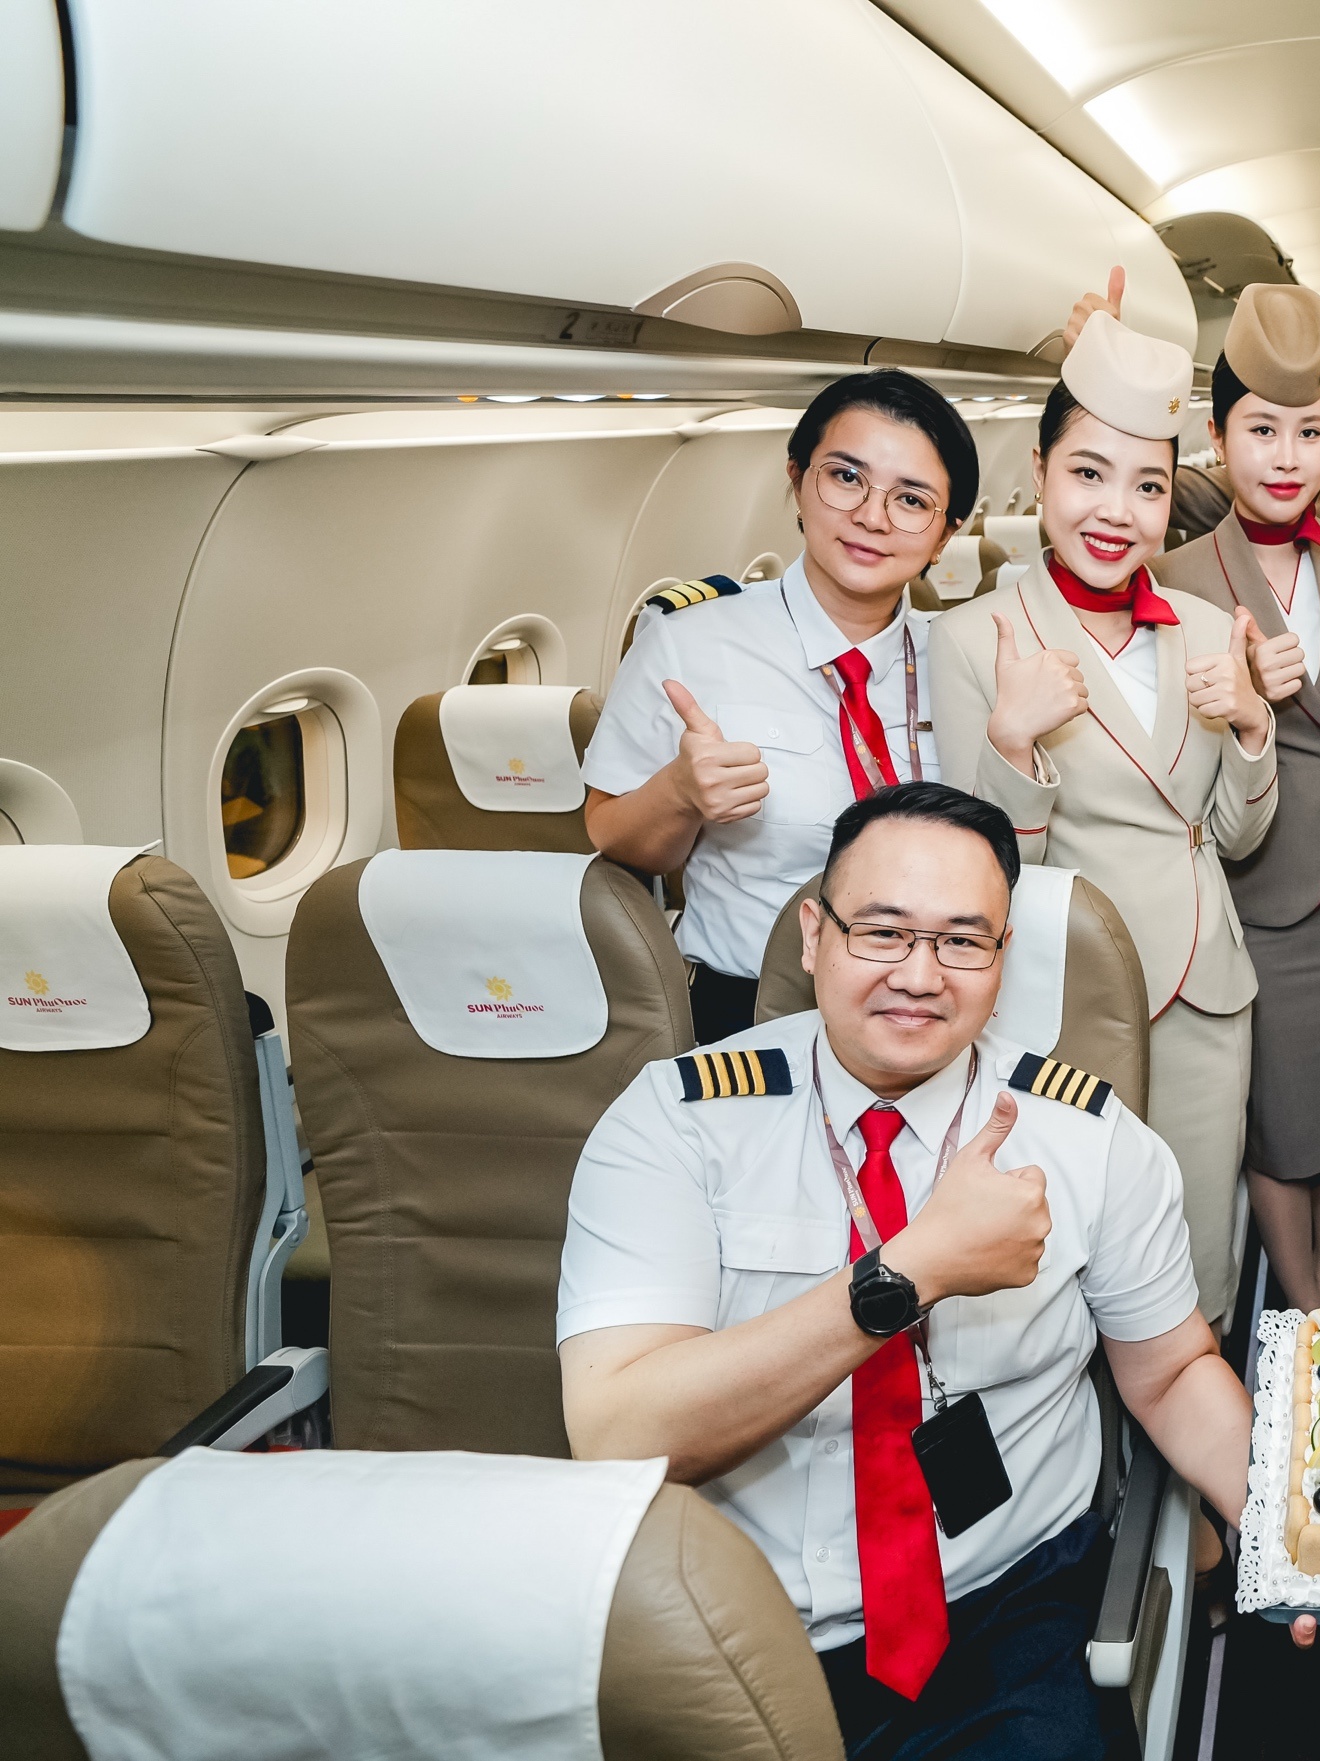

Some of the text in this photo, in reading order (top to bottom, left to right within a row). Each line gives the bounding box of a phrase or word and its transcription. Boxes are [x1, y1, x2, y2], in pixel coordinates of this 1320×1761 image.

[8, 997, 32, 1006] SUN
[467, 1004, 493, 1013] SUN
[850, 1192, 859, 1207] SUN
